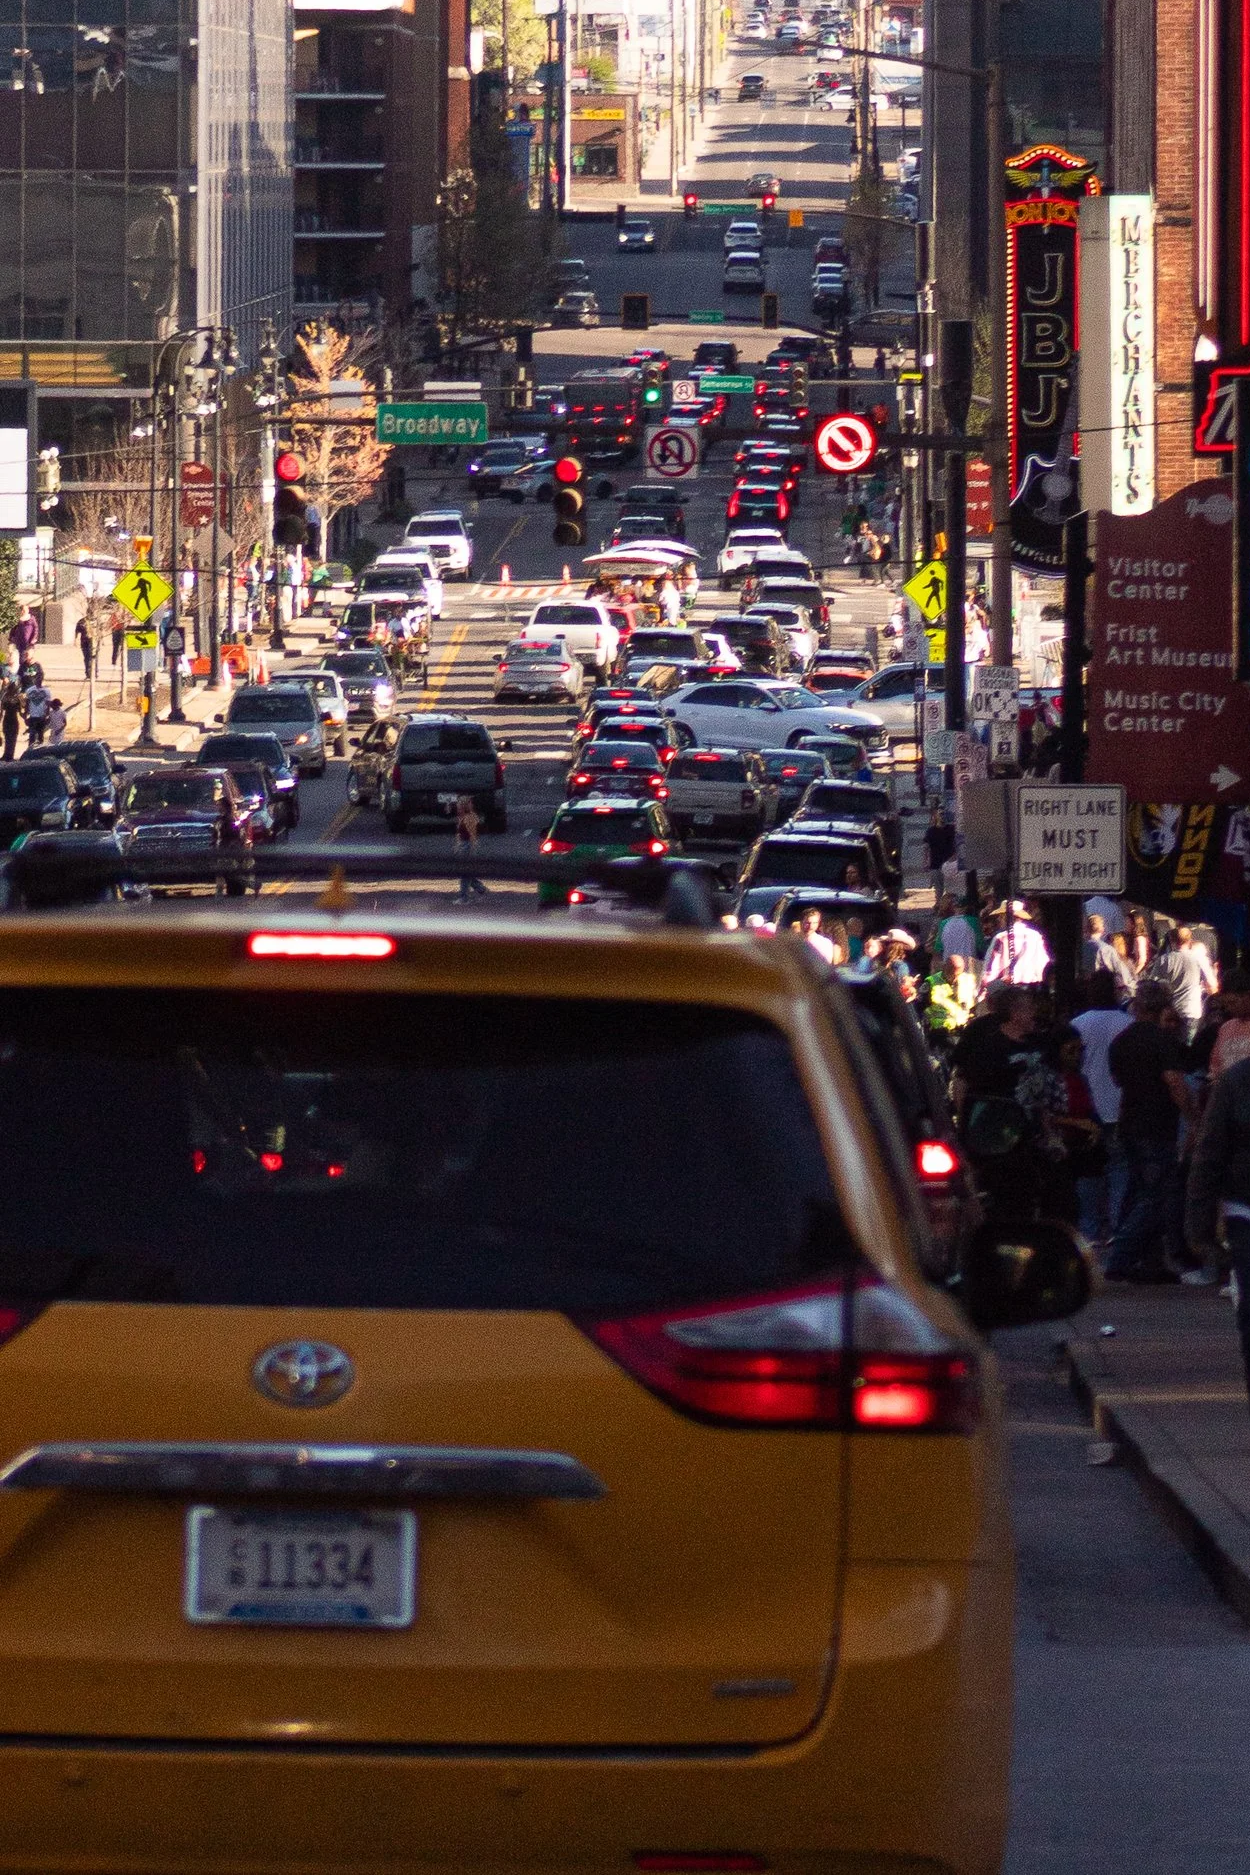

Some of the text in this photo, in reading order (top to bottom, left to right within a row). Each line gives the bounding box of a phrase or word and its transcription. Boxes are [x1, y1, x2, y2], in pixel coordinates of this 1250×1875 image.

[1117, 214, 1146, 506] MERCHANTS
[382, 413, 481, 439] Broadway
[1107, 556, 1187, 578] Visitor
[1107, 580, 1190, 601] Center
[1106, 624, 1158, 643] Frist
[1106, 646, 1144, 666] Art
[974, 692, 993, 713] OK
[1104, 689, 1227, 717] Music City
[1104, 712, 1186, 734] Center
[1024, 800, 1118, 817] RIGHT LANE
[1041, 829, 1100, 850] MUST
[1022, 862, 1118, 878] TURN RIGHT
[257, 1540, 375, 1591] 11334
